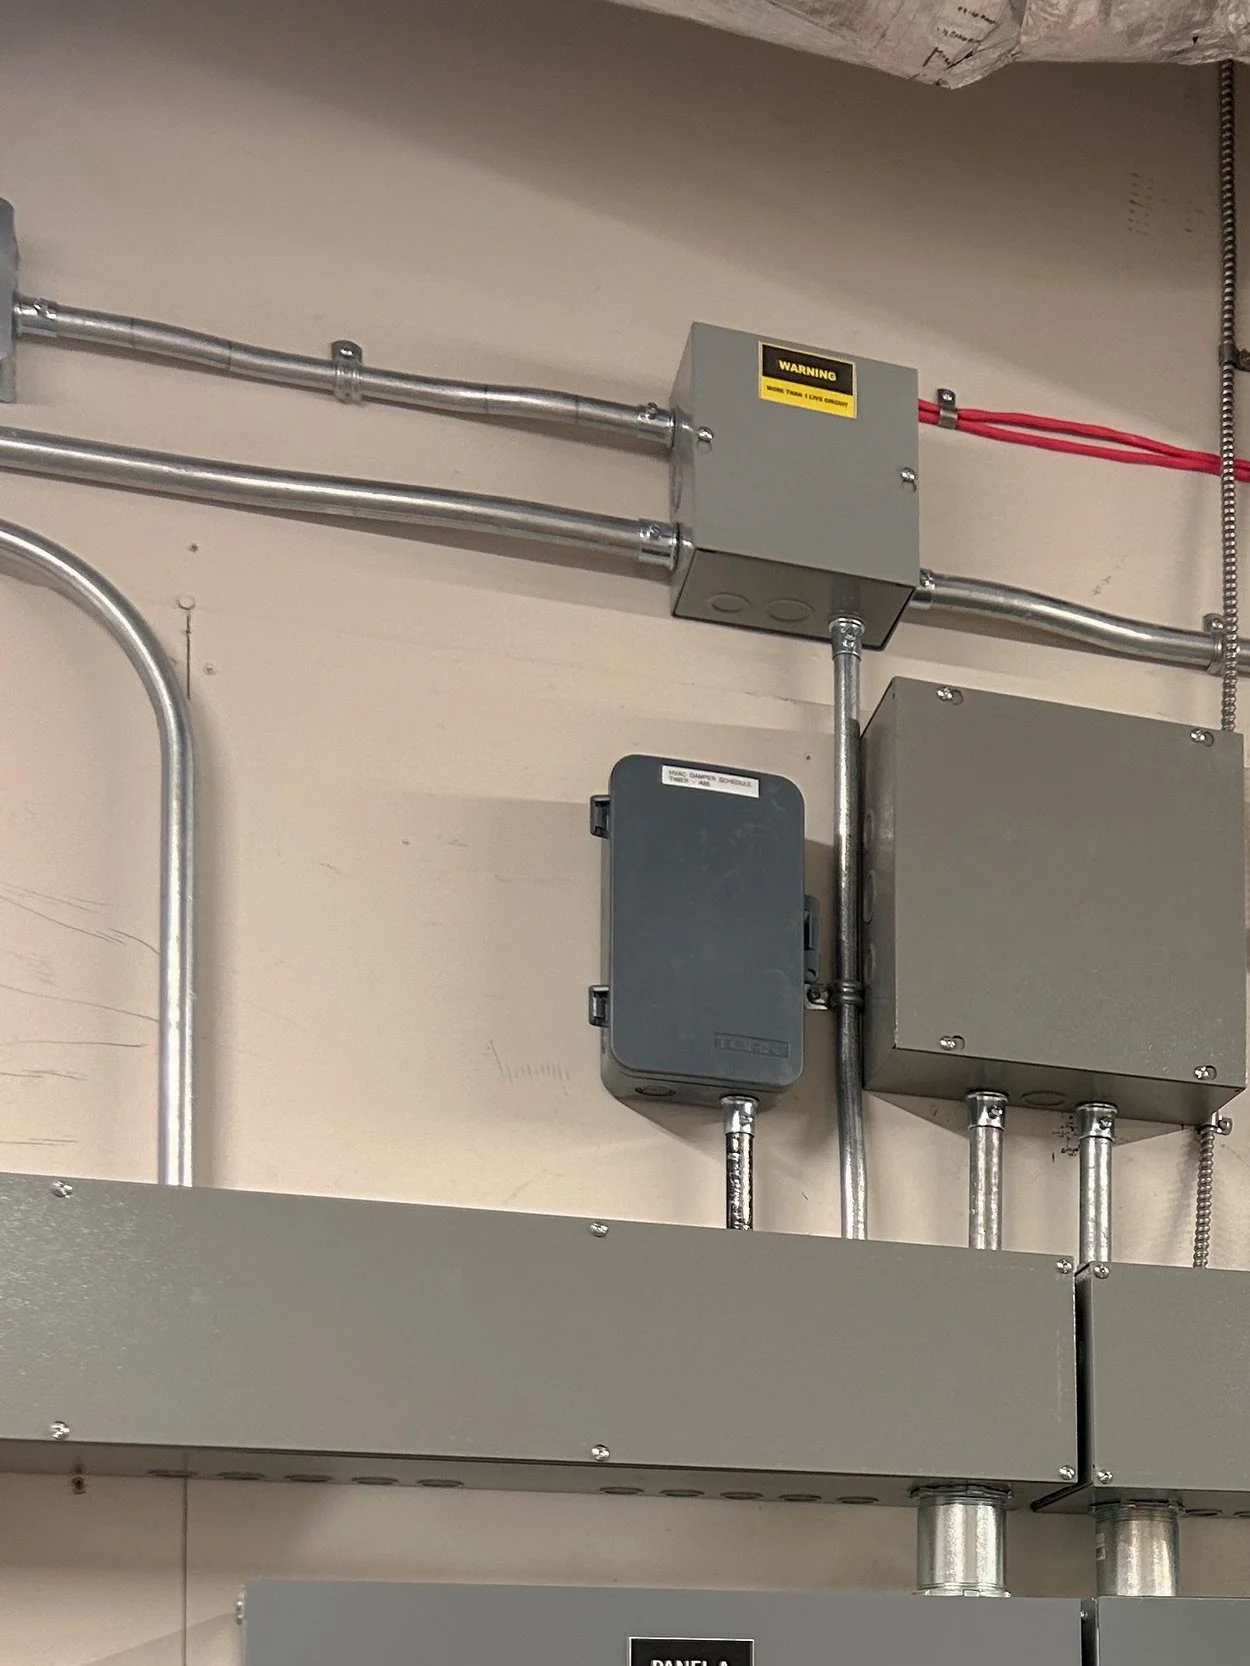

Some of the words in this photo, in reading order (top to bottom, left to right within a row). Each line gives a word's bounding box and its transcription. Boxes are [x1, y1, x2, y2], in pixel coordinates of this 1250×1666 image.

[778, 359, 837, 382] WARNING
[766, 384, 784, 394] MORE
[786, 389, 803, 398] THAN
[809, 394, 823, 403] LIVE
[824, 397, 849, 408] CIRCUIT
